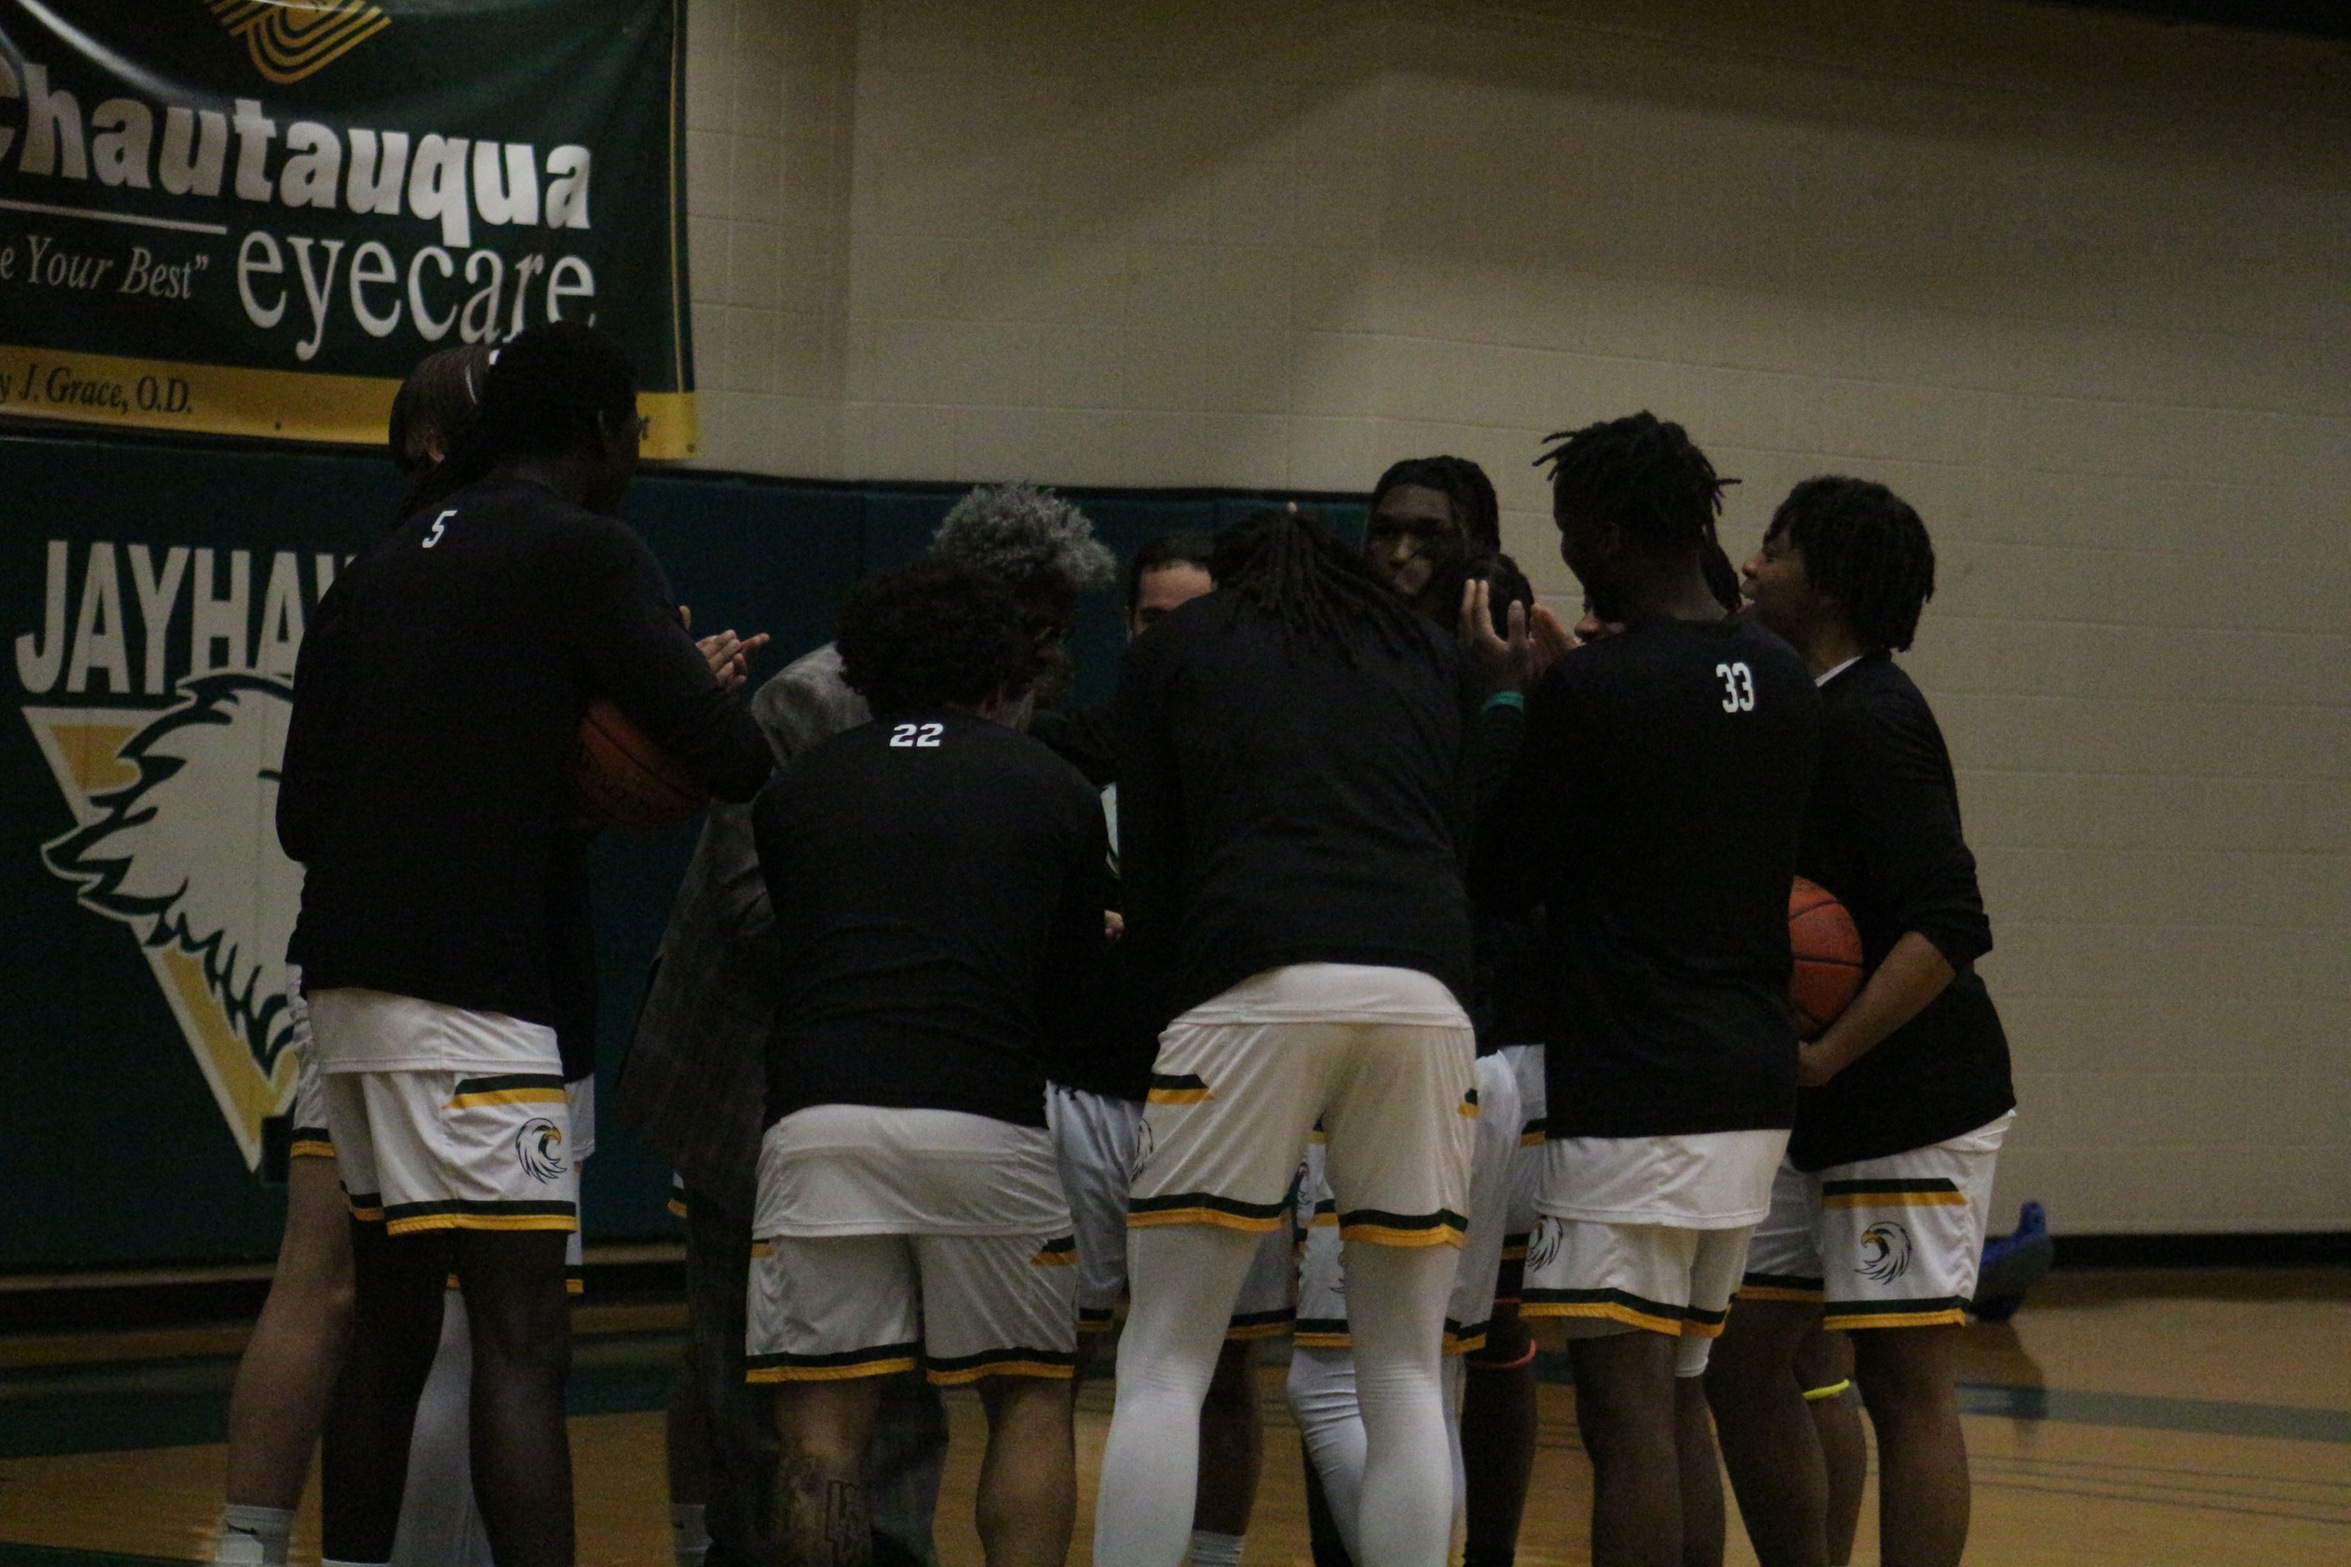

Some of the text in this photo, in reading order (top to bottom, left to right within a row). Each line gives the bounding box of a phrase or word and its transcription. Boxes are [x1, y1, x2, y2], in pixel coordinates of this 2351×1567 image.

[26, 234, 114, 290] Your
[236, 230, 596, 361] eyecare
[19, 363, 38, 402] J.
[47, 367, 128, 415] Grace,
[137, 375, 192, 413] O.D.
[422, 510, 458, 548] 5
[15, 539, 357, 695] JAYHA
[1716, 662, 1754, 713] 33
[889, 723, 943, 747] 22
